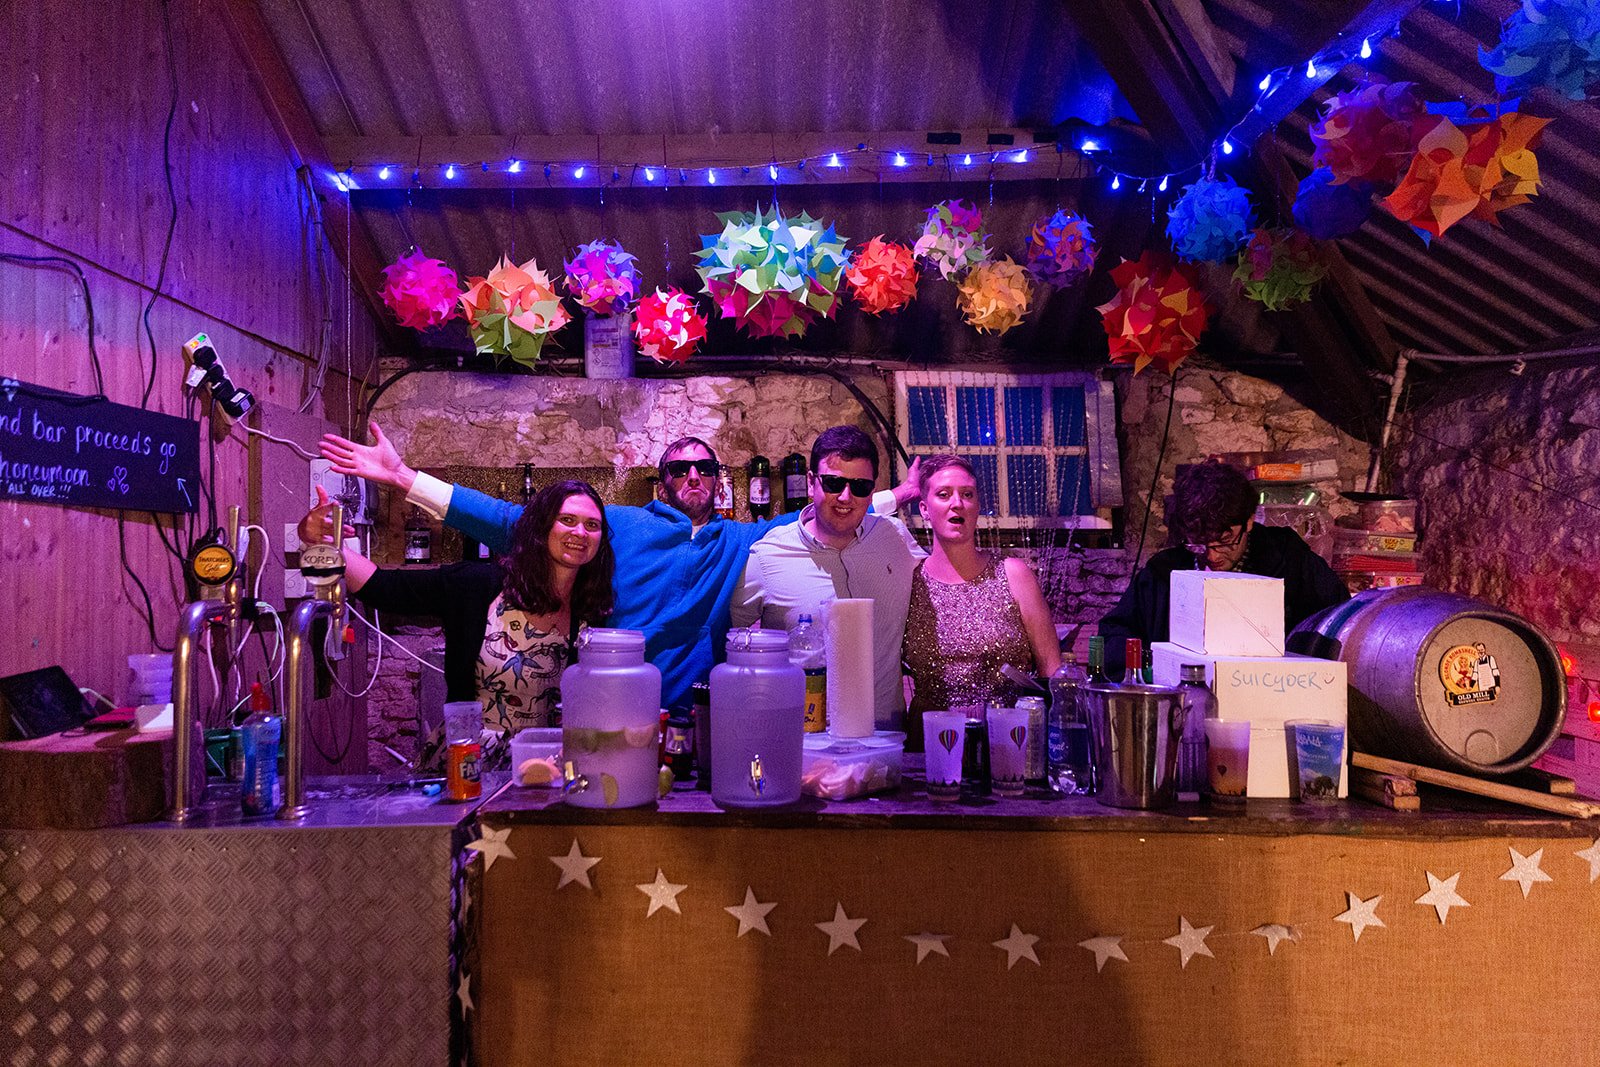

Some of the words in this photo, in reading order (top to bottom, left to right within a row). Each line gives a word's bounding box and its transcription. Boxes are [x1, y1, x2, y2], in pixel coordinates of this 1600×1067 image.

[33, 409, 67, 443] bar
[76, 425, 151, 455] proceeds
[159, 442, 177, 475] go
